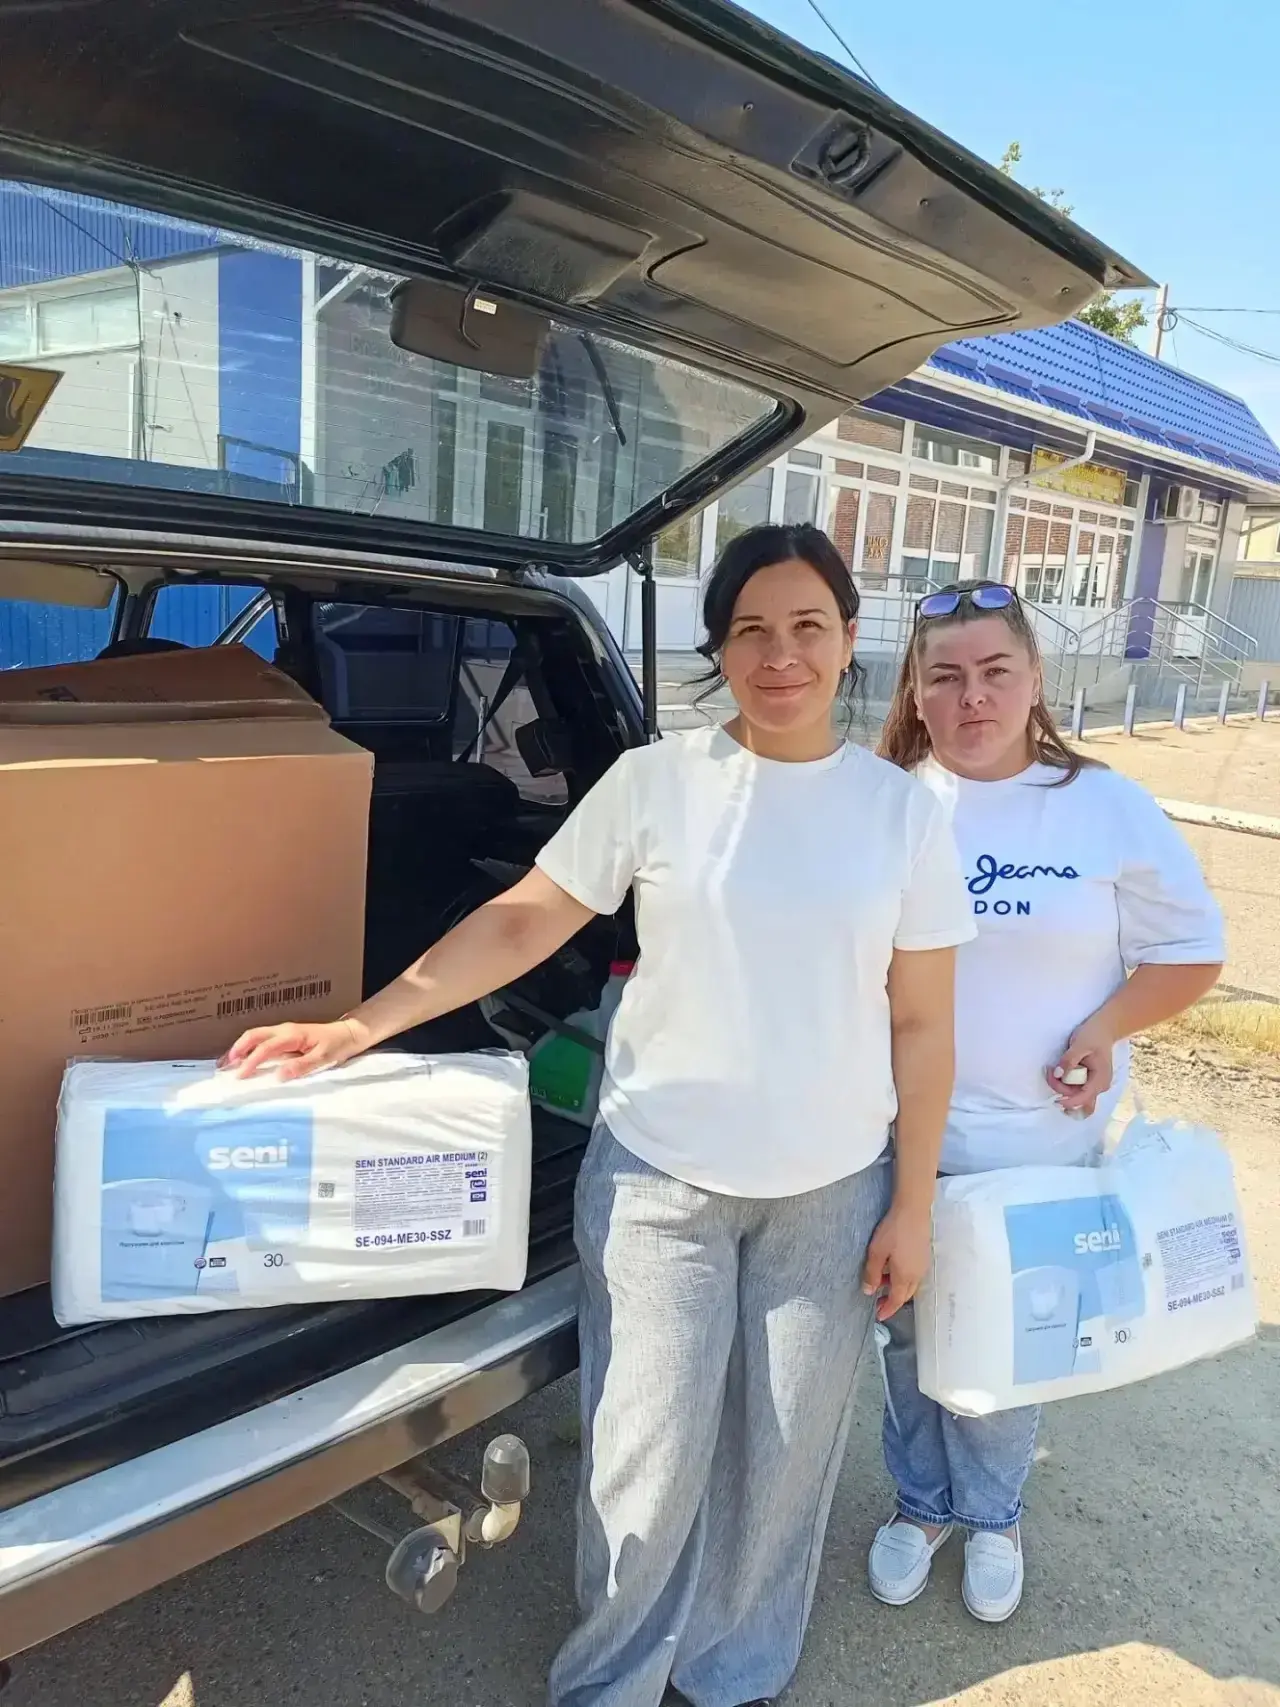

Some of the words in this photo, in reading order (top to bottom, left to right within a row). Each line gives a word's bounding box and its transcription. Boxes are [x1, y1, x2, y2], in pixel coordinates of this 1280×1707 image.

[207, 1138, 288, 1170] seni
[355, 1159, 376, 1168] SENI
[377, 1156, 424, 1168] STANDARD
[426, 1154, 441, 1164] AIR
[442, 1152, 476, 1162] MEDIUM
[477, 1151, 488, 1161] (2)
[465, 1168, 488, 1179] seni
[355, 1230, 452, 1248] SE-094-ME30-SSZ
[1074, 1222, 1122, 1255] seni
[263, 1253, 284, 1267] 30
